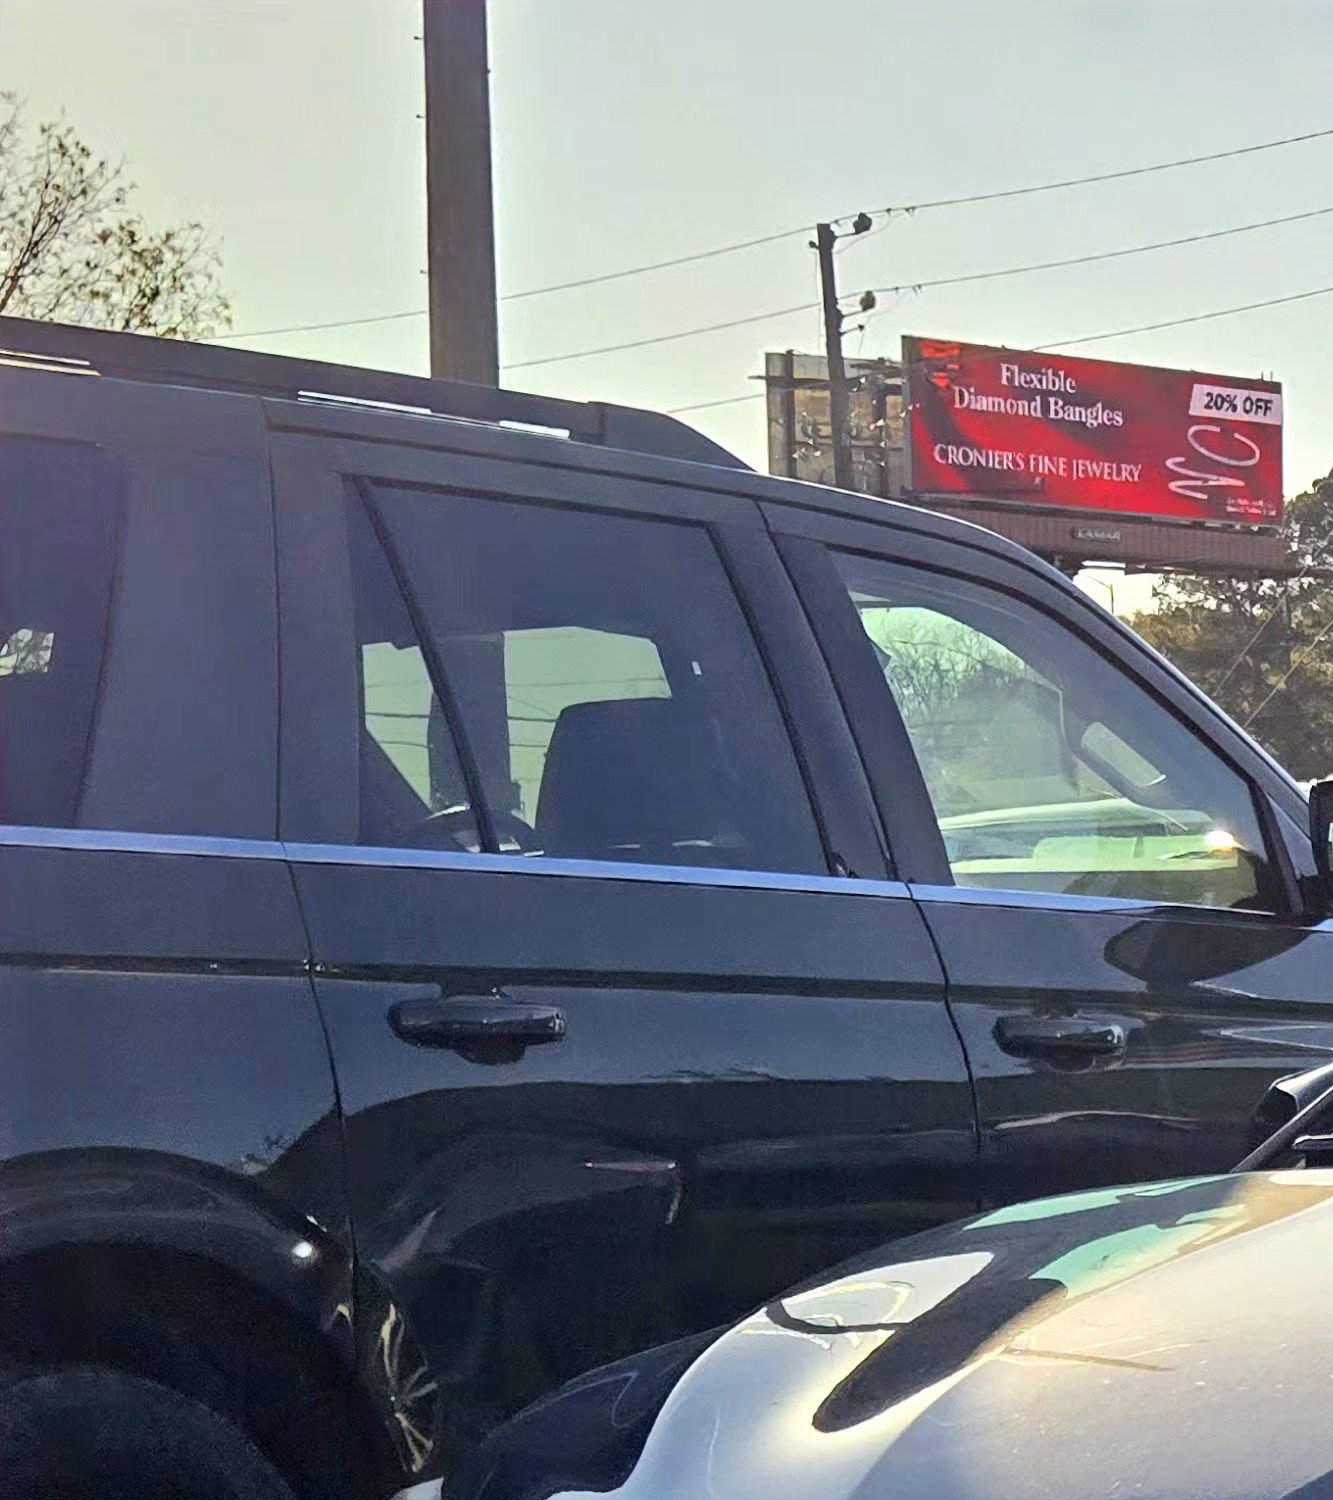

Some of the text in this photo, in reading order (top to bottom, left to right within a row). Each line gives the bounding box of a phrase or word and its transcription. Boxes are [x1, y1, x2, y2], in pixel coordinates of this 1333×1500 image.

[1000, 363, 1077, 393] Flexible
[952, 385, 1124, 428] Diamond Bangles
[1204, 392, 1274, 417] 20% OFF
[933, 443, 1142, 482] CRONIER'S FINE JEWELRY
